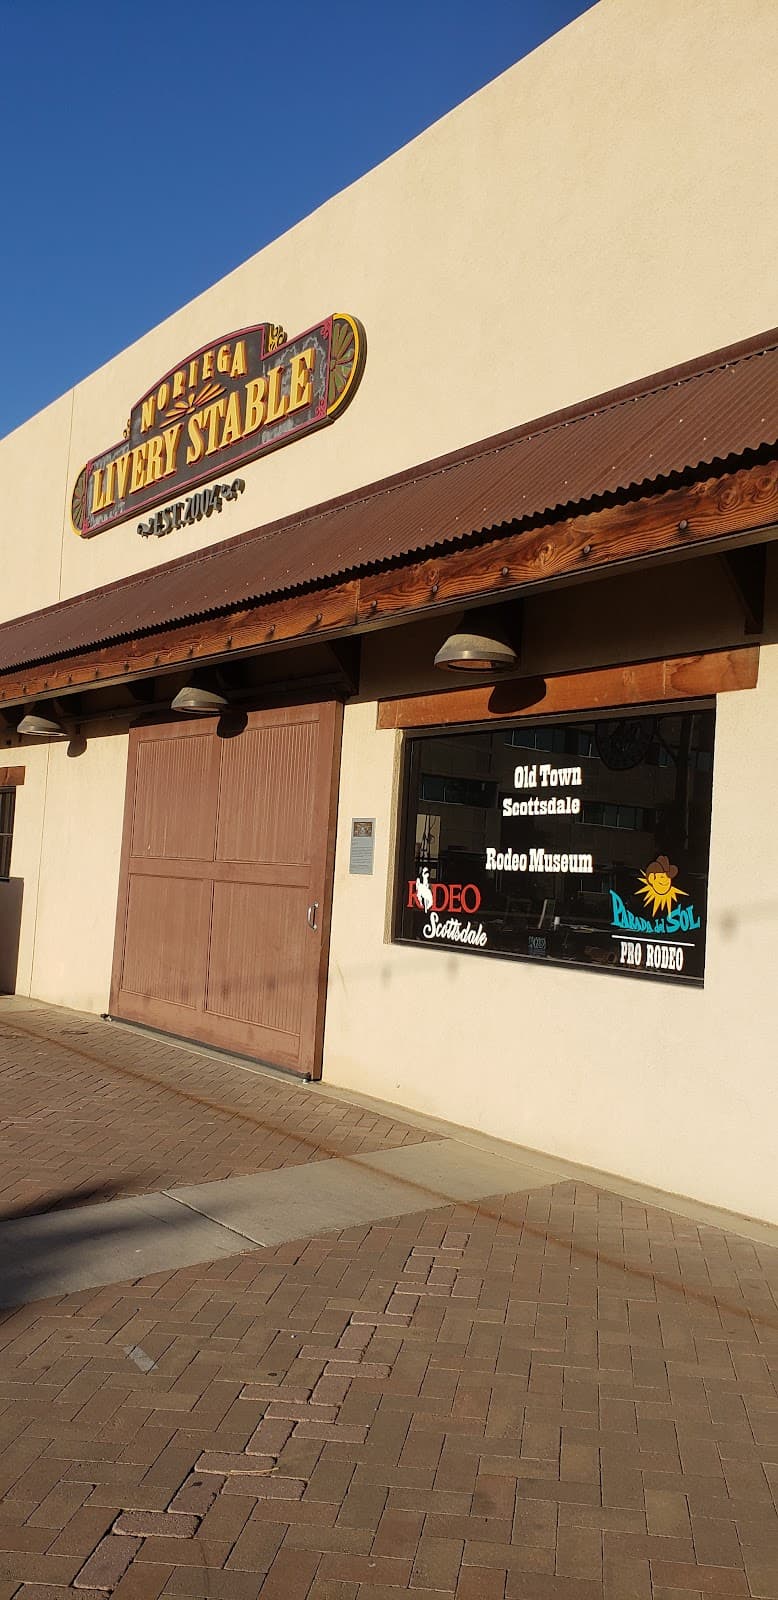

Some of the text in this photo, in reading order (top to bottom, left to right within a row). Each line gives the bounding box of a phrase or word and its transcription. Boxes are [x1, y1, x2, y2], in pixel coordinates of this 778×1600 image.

[140, 340, 248, 434] NORIEGA
[90, 347, 317, 515] LIVERY STABLE
[514, 763, 582, 789] Old Town
[502, 797, 581, 817] Scottsdale
[485, 847, 593, 873] Rodeo Museum
[406, 880, 482, 915] RDEO
[422, 911, 488, 947] Scottsdale
[665, 903, 701, 934] SOL
[620, 941, 685, 972] PRO RODEO
